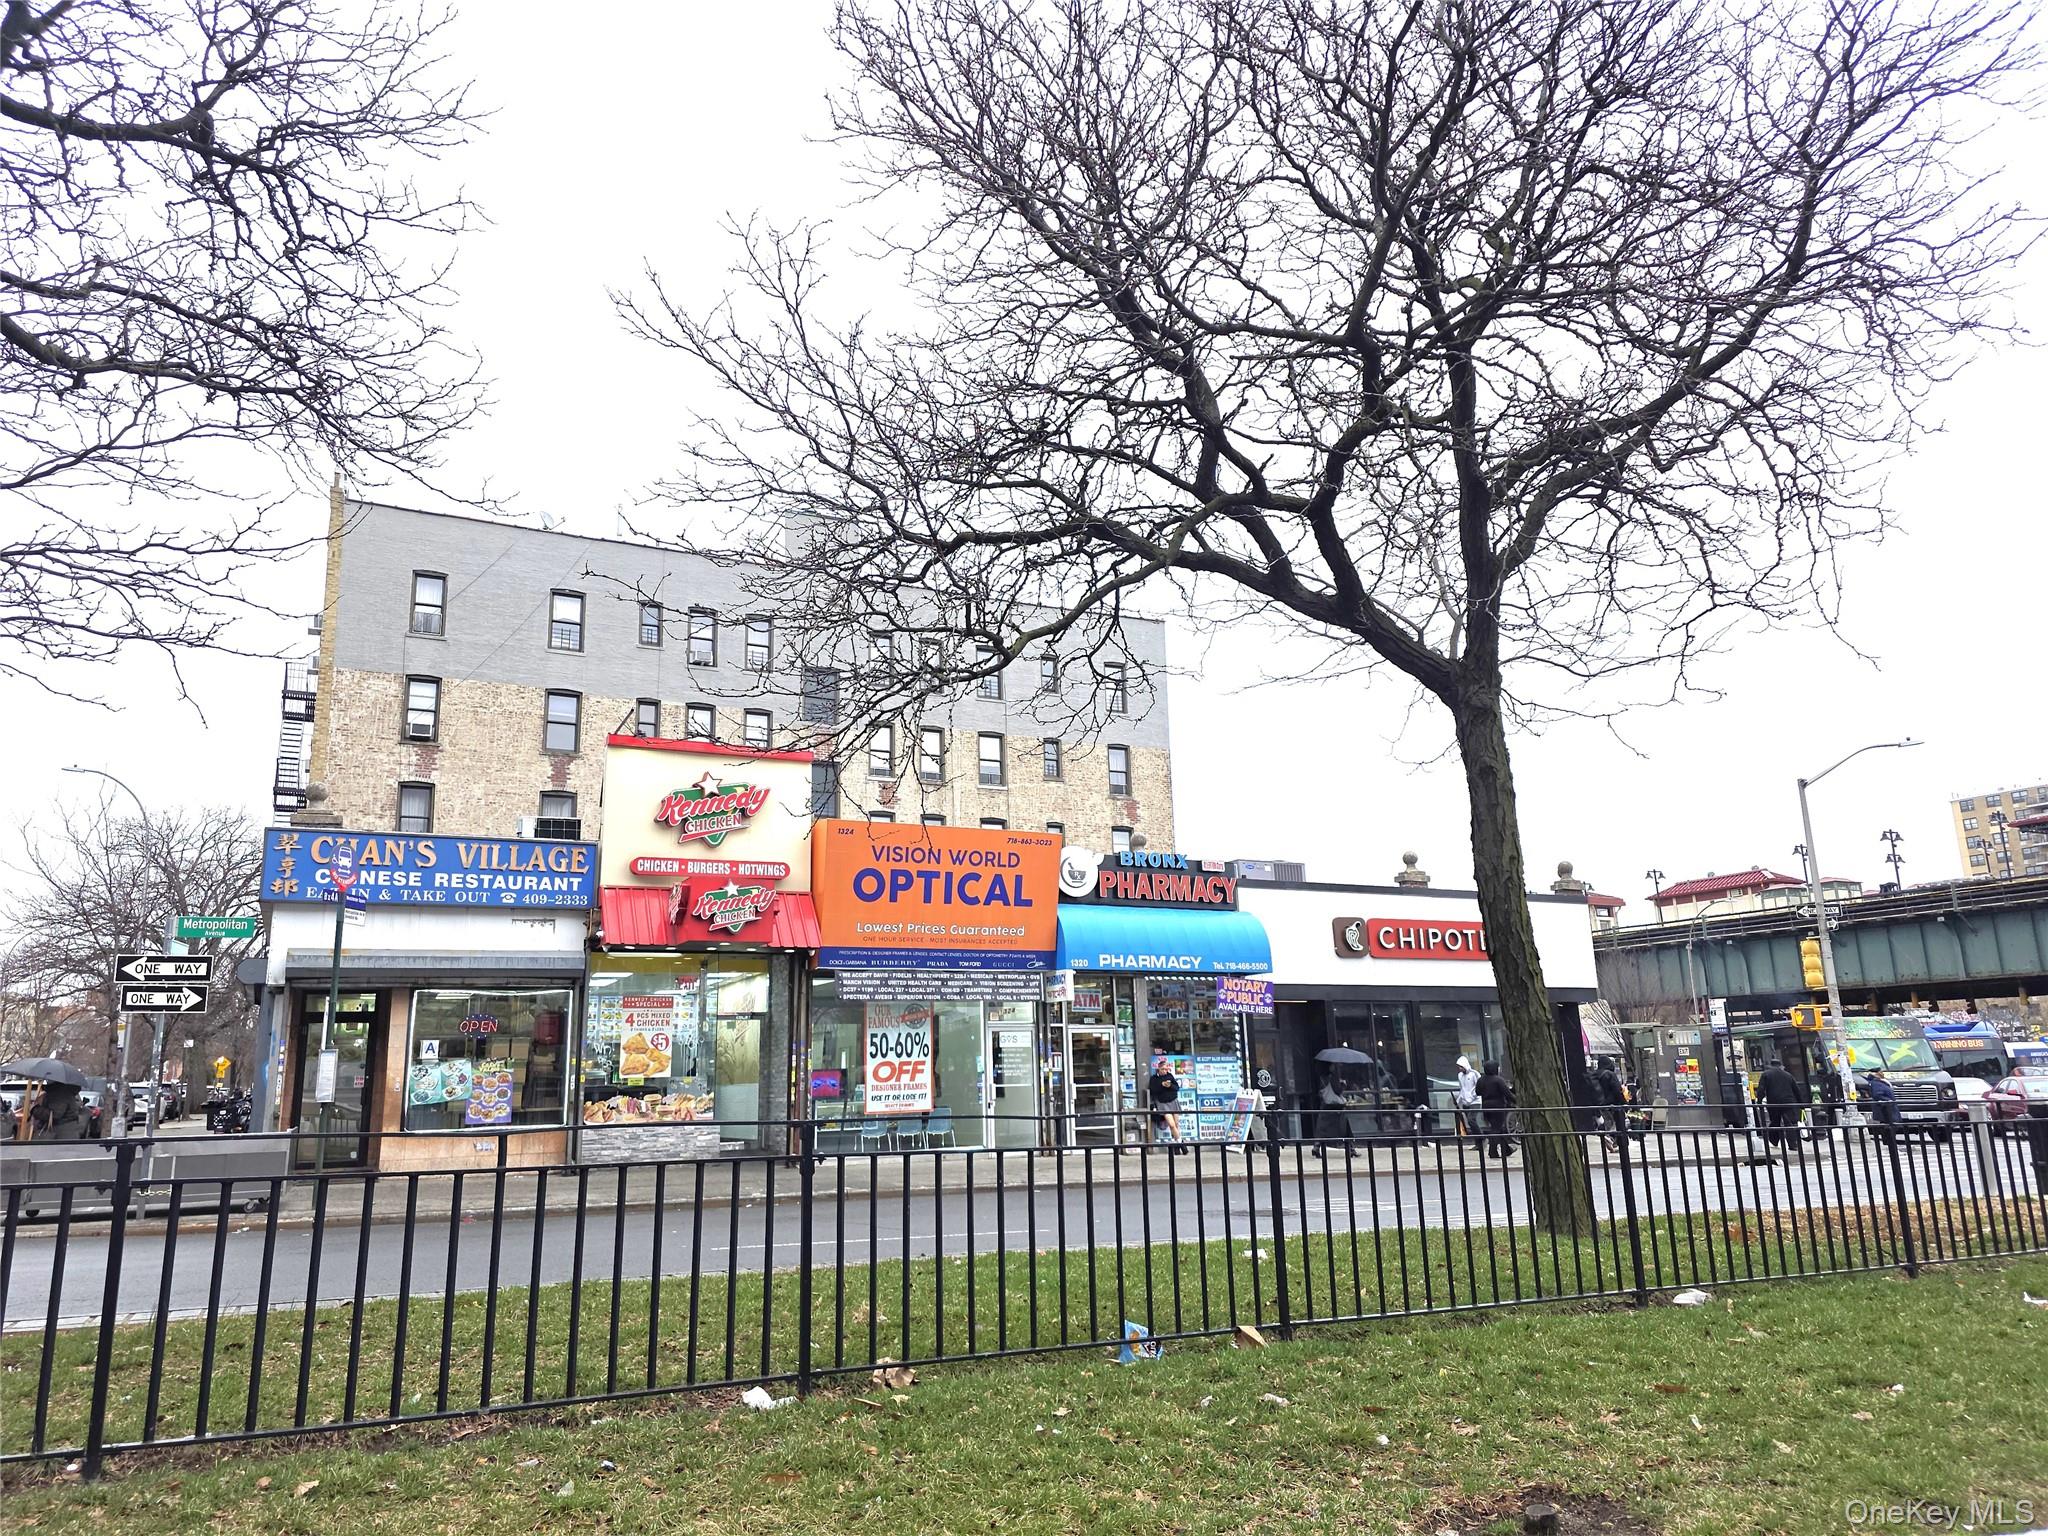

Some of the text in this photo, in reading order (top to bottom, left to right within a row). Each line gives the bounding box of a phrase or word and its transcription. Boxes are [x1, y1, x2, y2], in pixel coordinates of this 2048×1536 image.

[657, 784, 770, 826] Kennedy
[685, 814, 741, 833] CHICKEN
[456, 842, 589, 874] VILLAGE
[872, 846, 1020, 868] VISION WORLD
[1119, 850, 1189, 870] BRONX
[637, 859, 786, 877] CHICKEN BURGERS HOTWINGS
[315, 868, 422, 887] CNESE
[435, 872, 583, 892] RESTAURANT
[853, 867, 1033, 907] OPTICAL
[1099, 870, 1238, 904] PHARMACY
[379, 889, 392, 901] &
[400, 889, 446, 902] TAKE
[455, 890, 491, 903] OUT
[522, 893, 589, 906] 409-2333
[692, 887, 777, 920] Kennedy
[714, 908, 756, 924] CHICKEN
[183, 918, 248, 931] Metropolitan
[857, 922, 1025, 937] Lowest Prices Guaranteed
[1379, 926, 1486, 951] CHIPOTL
[135, 963, 202, 974] ONE WAY
[1070, 959, 1088, 967] 1320
[1099, 954, 1202, 969] PHARMACY
[1225, 962, 1268, 970] 718-466-5500
[1223, 978, 1267, 993] NOTARY
[131, 994, 191, 1004] ONE WAY
[1073, 993, 1100, 1008] ATM
[1226, 991, 1264, 1005] PUBLIC
[874, 1003, 892, 1017] OUR
[1218, 1003, 1273, 1014] AVAILABLE HERE
[459, 1020, 498, 1033] OPEN
[625, 1012, 636, 1027] 4
[636, 1019, 671, 1027] CHICKEN
[868, 1016, 900, 1029] FAMOUS
[425, 1042, 436, 1054] A
[652, 1034, 667, 1051] $5
[870, 1031, 930, 1059] 50-60%
[1932, 1040, 1984, 1049] TRAINING BUS
[872, 1061, 926, 1083] OFF
[871, 1082, 928, 1091] DESIGNER FRAMES
